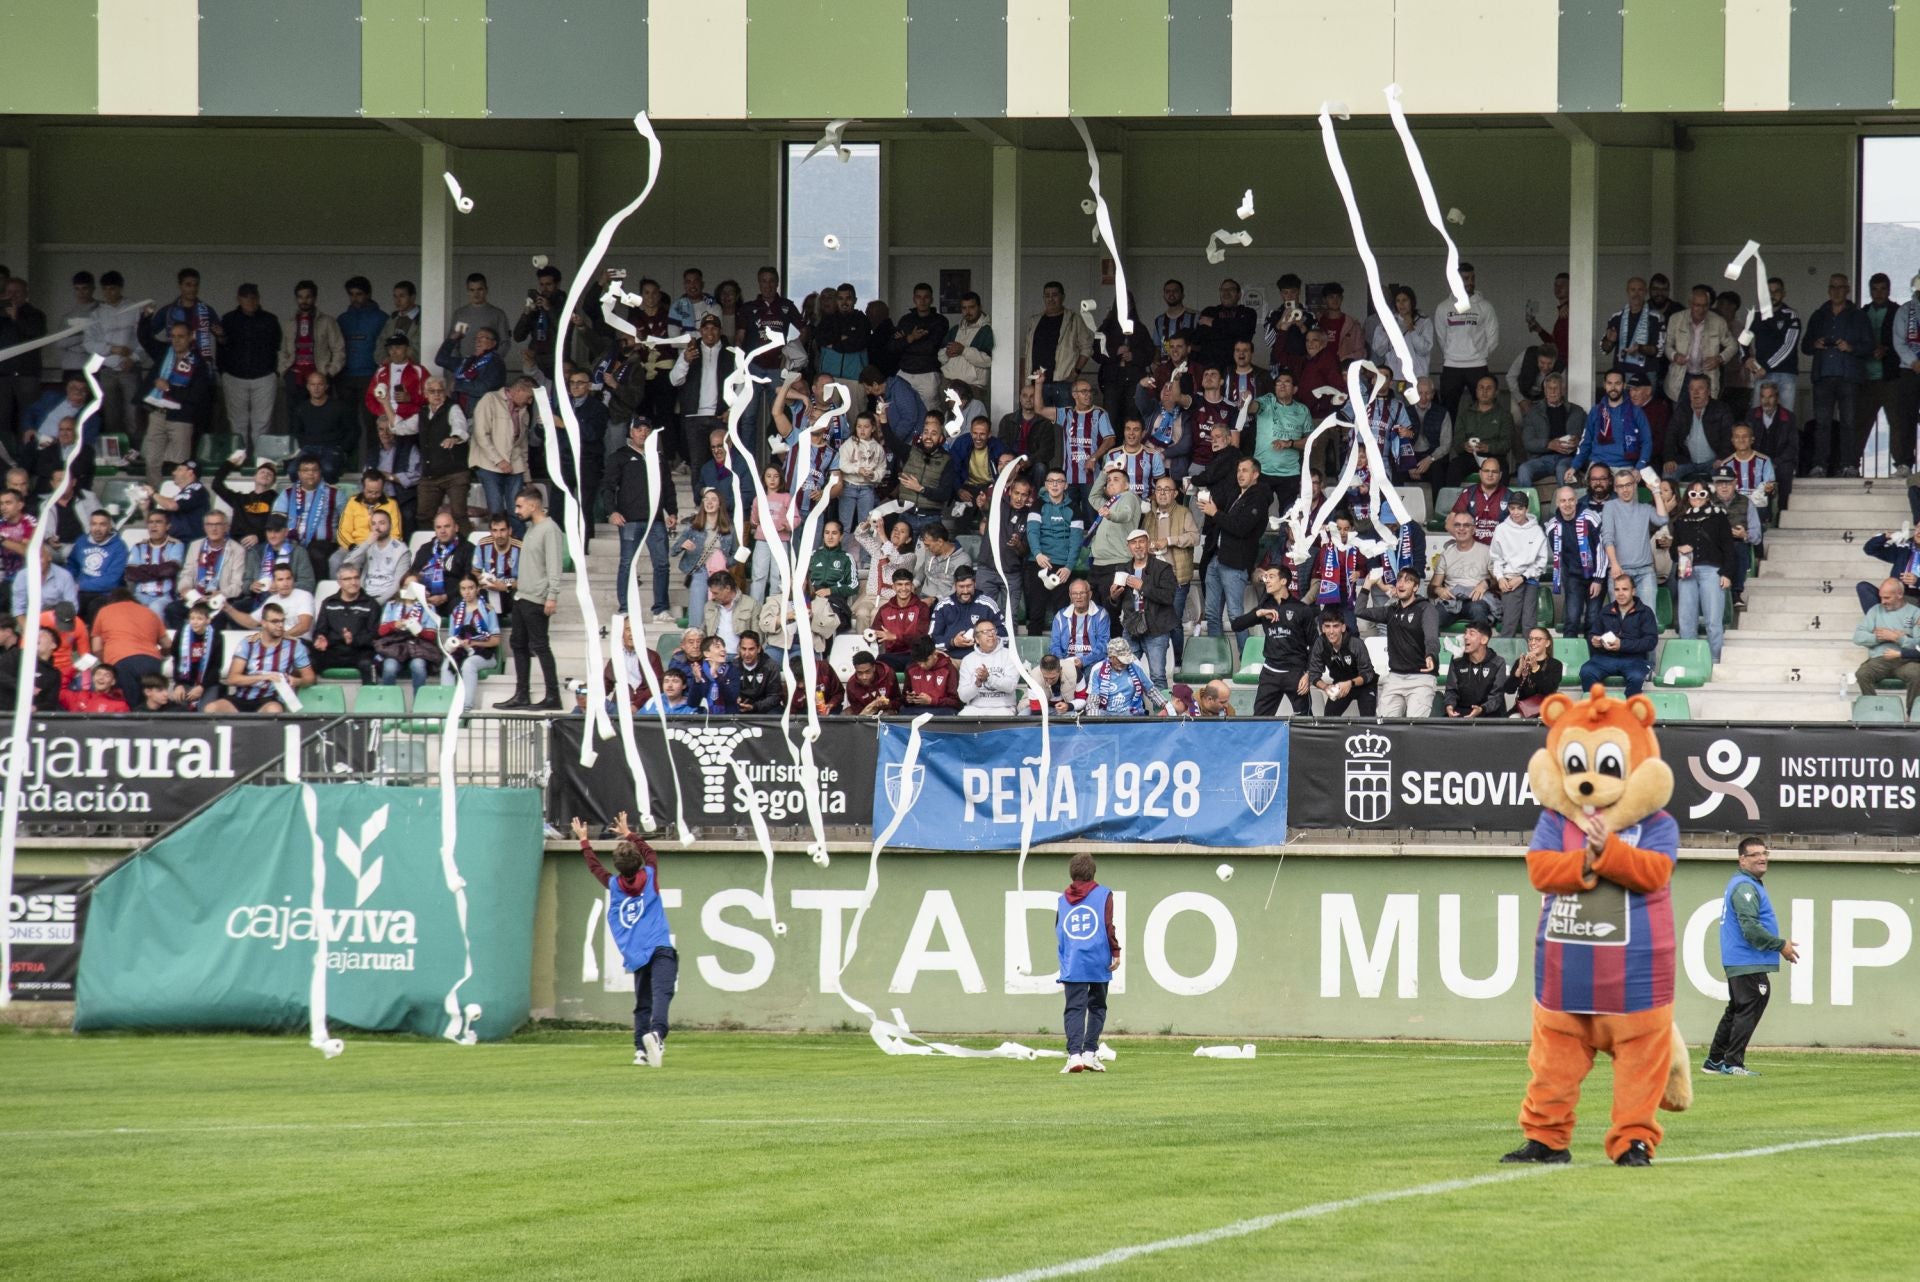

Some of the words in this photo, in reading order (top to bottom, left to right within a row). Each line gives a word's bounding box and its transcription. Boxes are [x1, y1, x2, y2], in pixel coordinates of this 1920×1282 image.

[1811, 616, 1821, 629] 4
[1791, 669, 1801, 682] 3
[737, 760, 818, 782] Turism
[820, 767, 838, 782] de
[1781, 757, 1894, 778] INSTITUTO
[962, 756, 1078, 823] PEÑA
[1091, 761, 1200, 817] 1928
[1401, 771, 1541, 805] SEGOVIA
[1779, 784, 1916, 809] DEPORTES
[733, 783, 846, 820] Segoia
[48, 927, 71, 939] SLU
[226, 895, 418, 950] cajaviva
